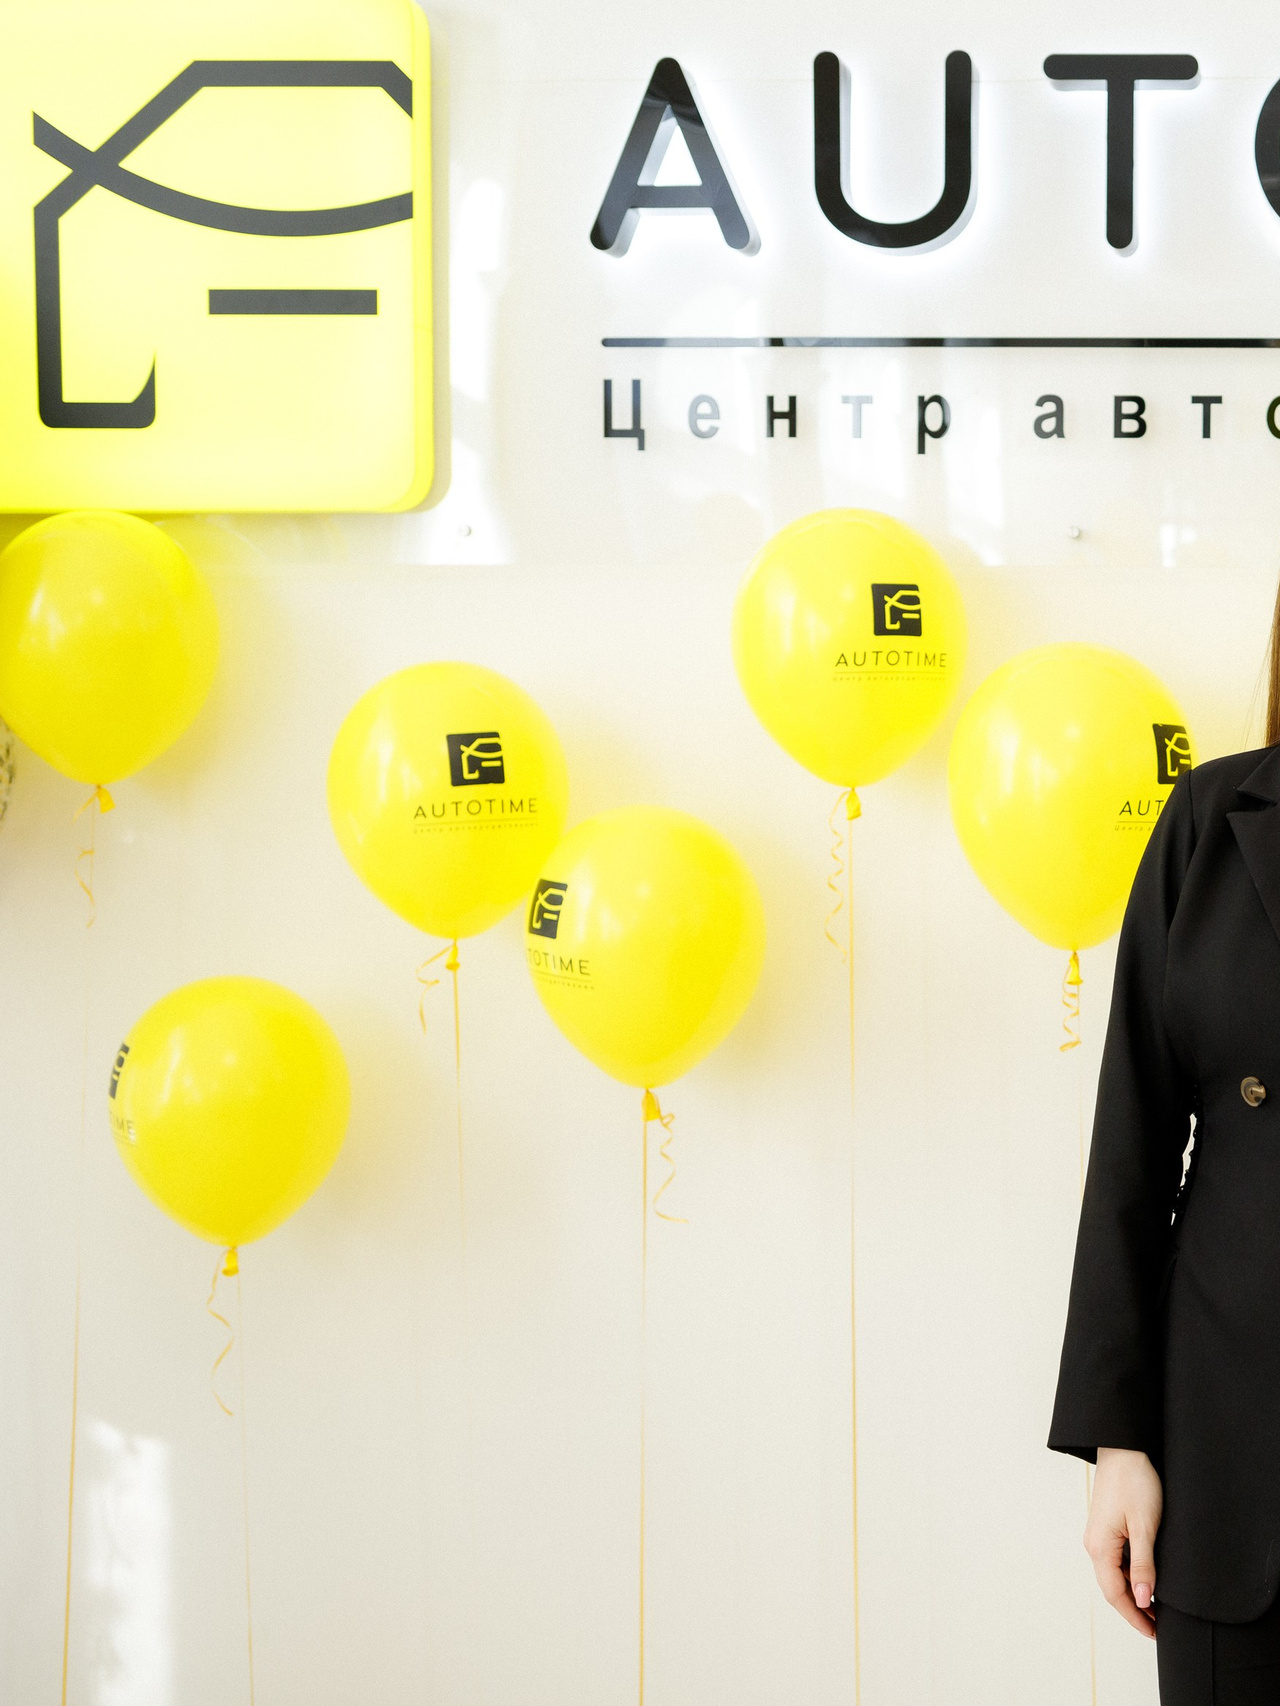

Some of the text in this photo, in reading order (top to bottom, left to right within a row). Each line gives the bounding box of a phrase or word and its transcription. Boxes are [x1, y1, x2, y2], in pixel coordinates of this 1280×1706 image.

[602, 378, 952, 454] Центр
[834, 650, 948, 668] AUTOTIME
[413, 797, 538, 820] AUTOTIME
[1118, 799, 1165, 816] AUT
